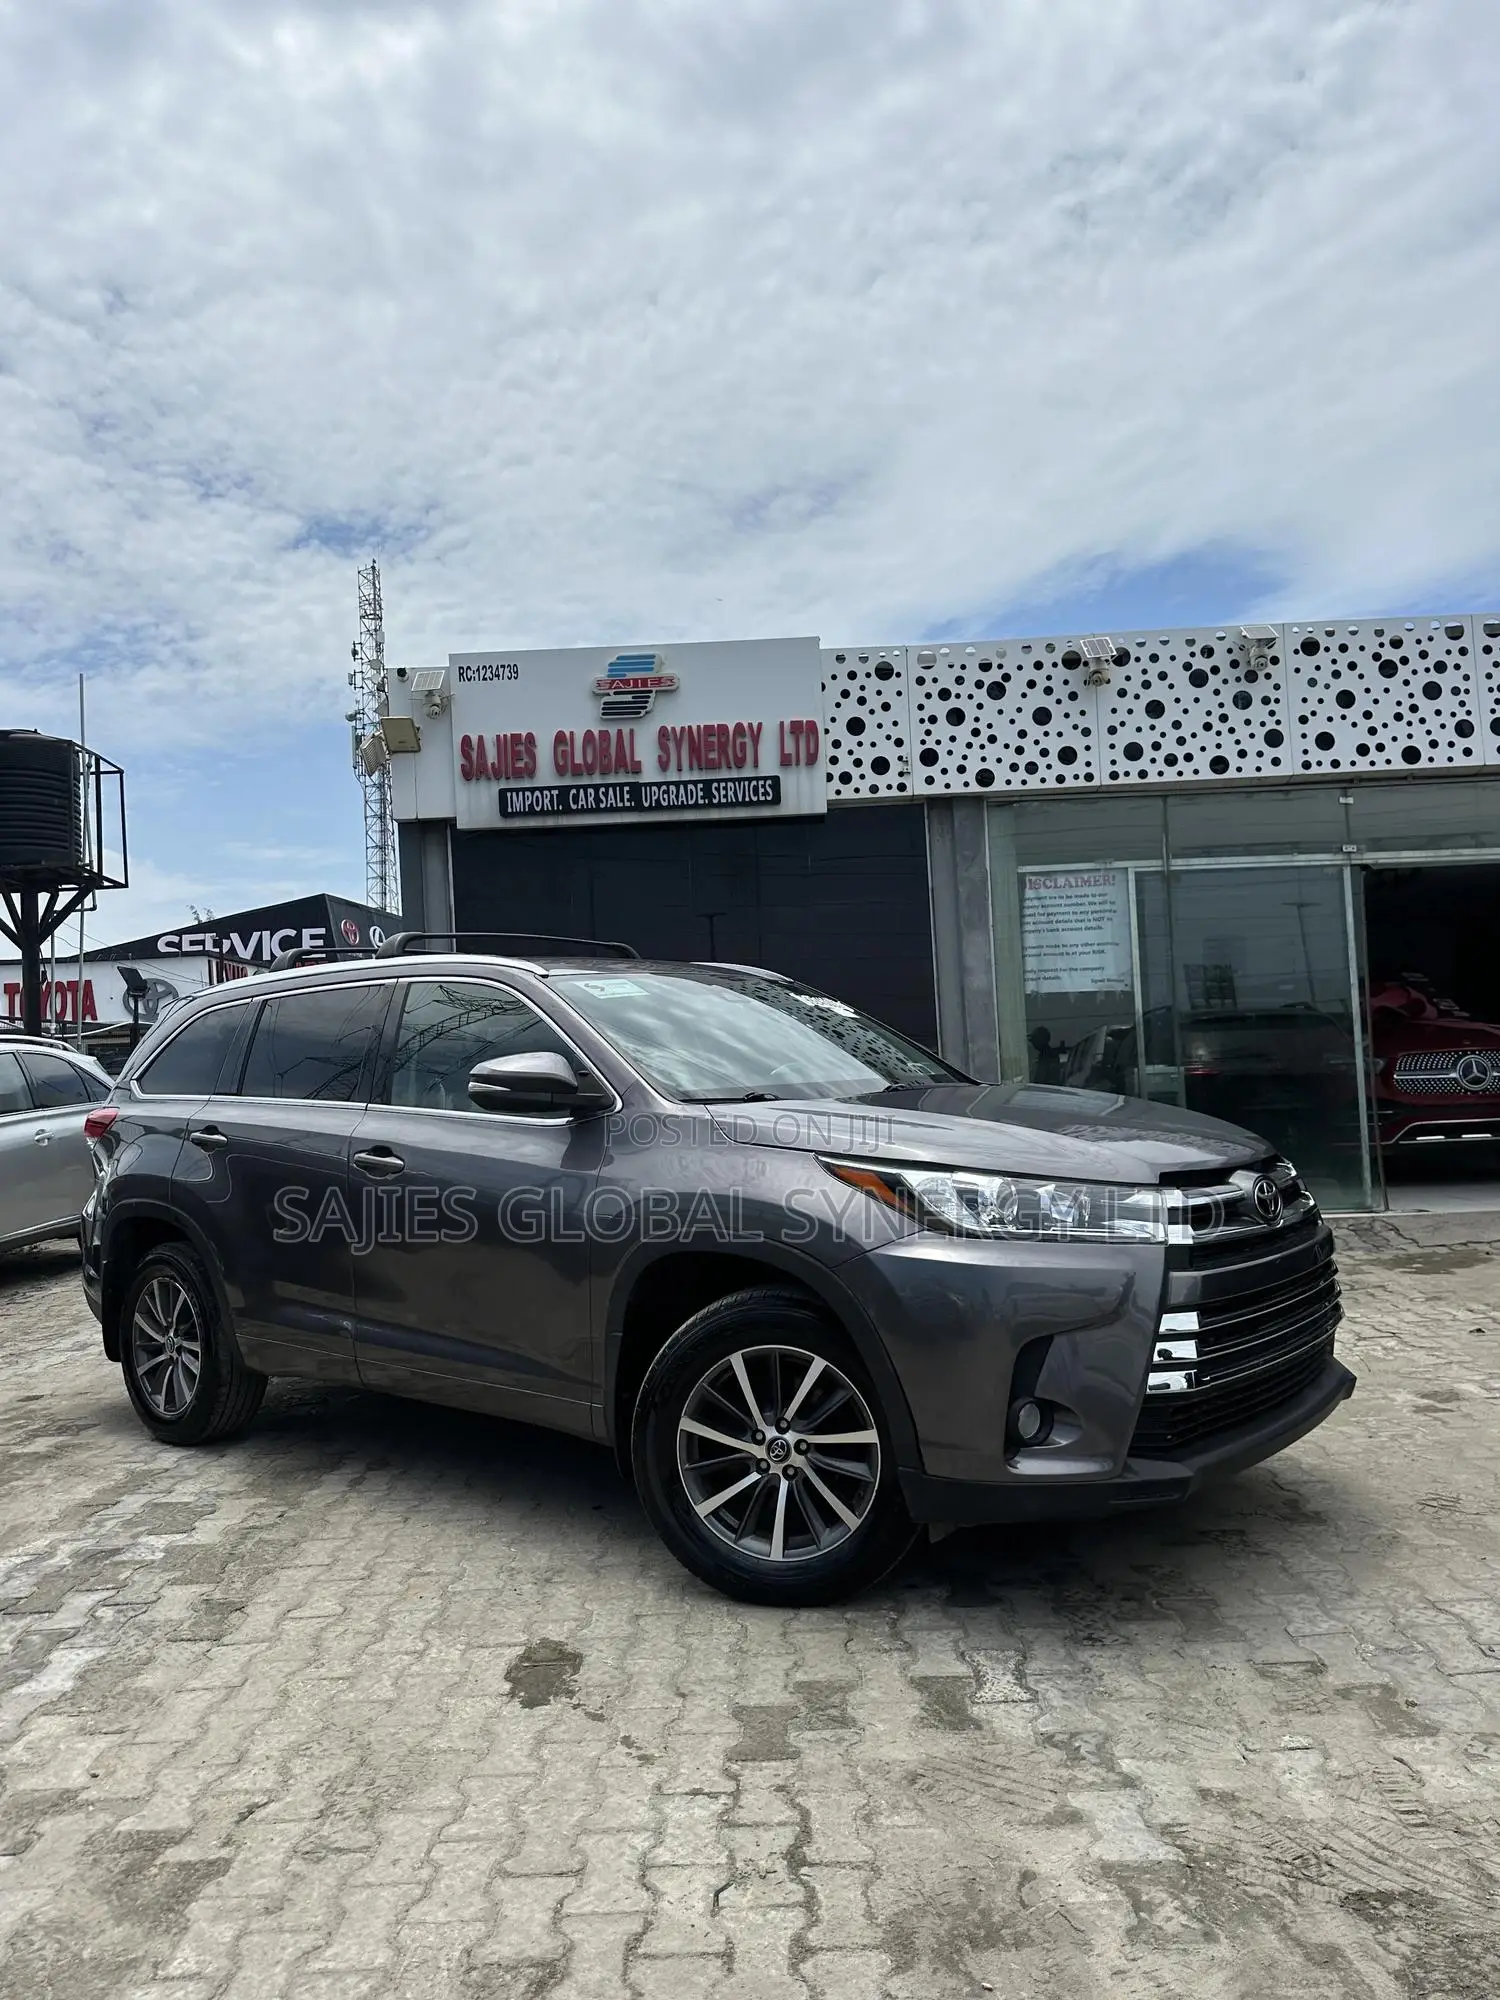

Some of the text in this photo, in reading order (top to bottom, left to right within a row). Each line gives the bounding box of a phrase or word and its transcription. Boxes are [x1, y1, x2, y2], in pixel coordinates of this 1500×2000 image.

[458, 664, 519, 682] RC:1234739
[460, 719, 820, 782] SAJIES GLOBAL SYNERGY LTD
[506, 779, 773, 813] IMPORT. CAR SALE. UPGRADE. SERVICES
[1027, 874, 1116, 890] ISCLAIMER!
[4, 980, 98, 1024] TYOTA
